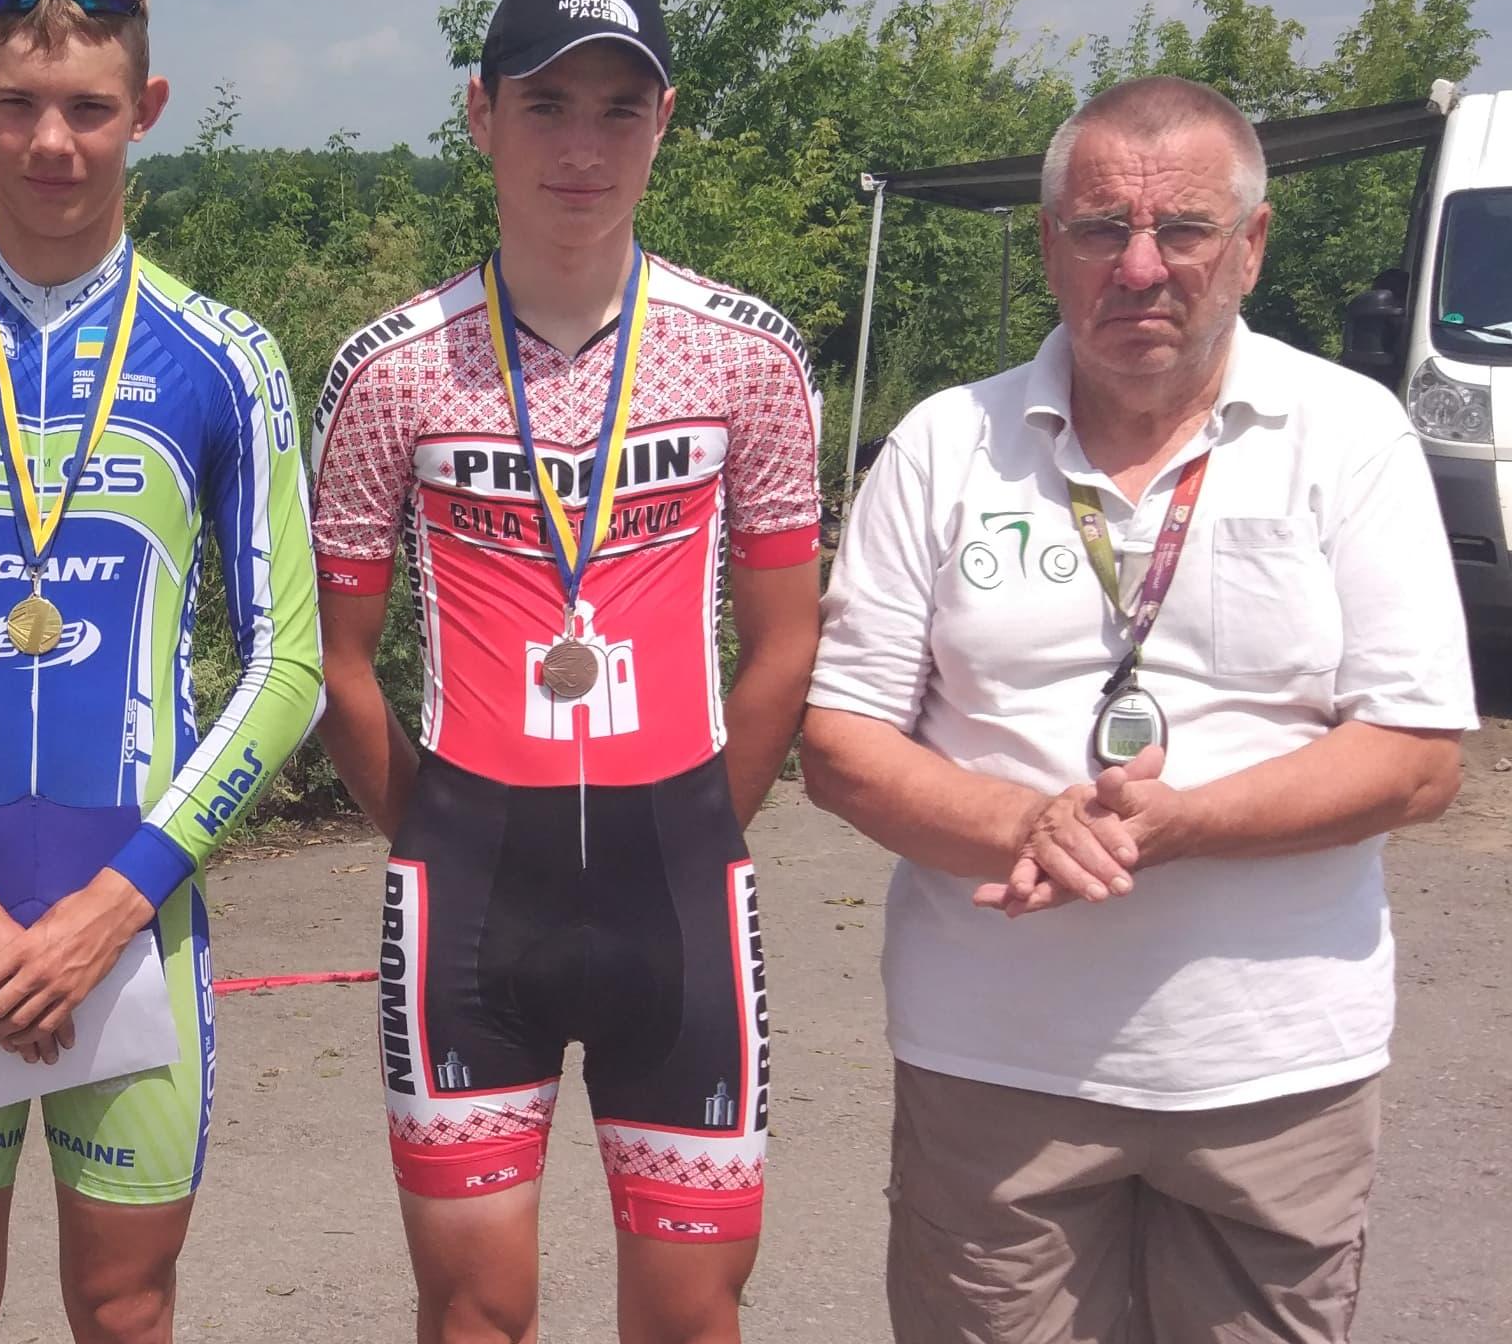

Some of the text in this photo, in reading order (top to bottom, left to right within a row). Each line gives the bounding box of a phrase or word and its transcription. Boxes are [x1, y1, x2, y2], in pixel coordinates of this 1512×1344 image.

[570, 8, 610, 19] FACE
[122, 372, 157, 383] UKRAINE
[183, 292, 296, 453] KOLSS
[314, 312, 416, 434] PROMIN
[449, 502, 522, 542] BILA
[123, 698, 137, 764] KOLSS
[193, 746, 264, 837] kalas
[380, 870, 417, 1096] PROMIN
[45, 1124, 136, 1168] KRAINE
